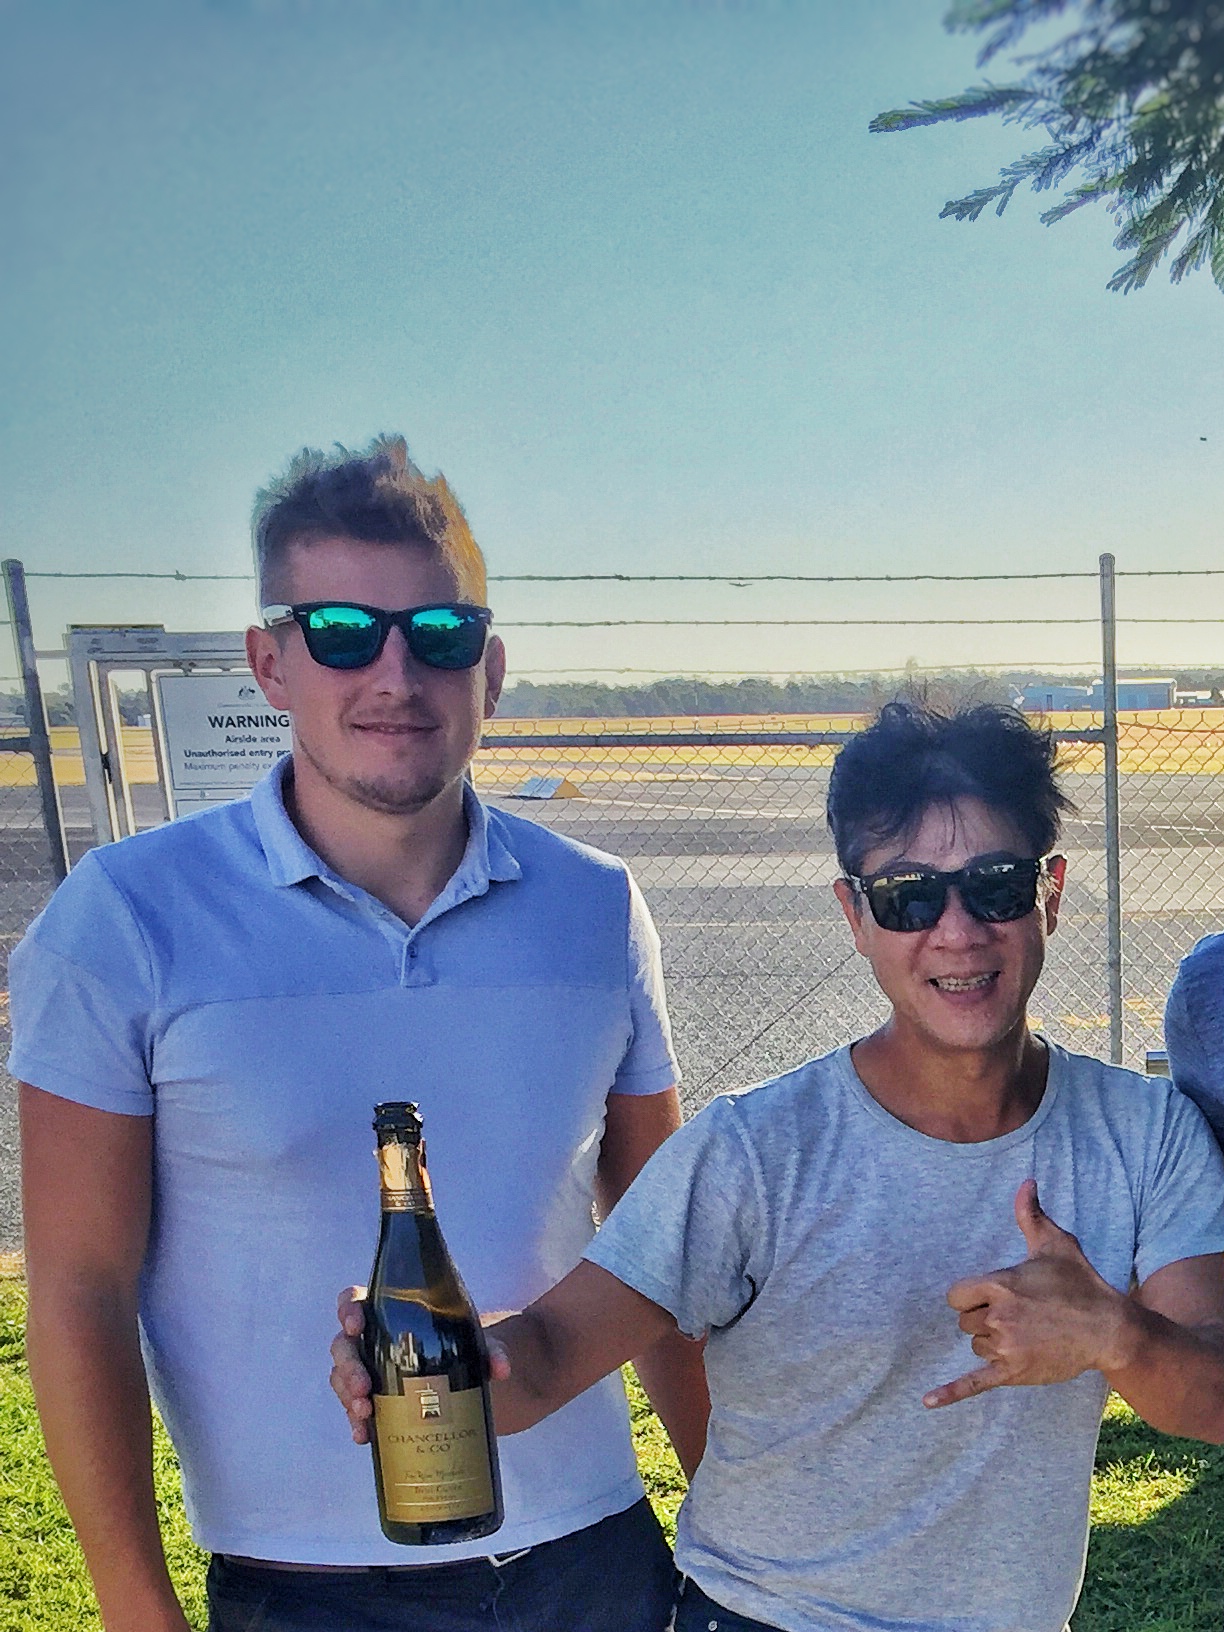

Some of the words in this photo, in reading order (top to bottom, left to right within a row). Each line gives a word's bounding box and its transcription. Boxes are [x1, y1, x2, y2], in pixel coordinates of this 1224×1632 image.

[208, 714, 290, 728] WARNING
[225, 735, 257, 743] Airside
[184, 749, 246, 758] Unauthorised
[249, 750, 273, 758] entry
